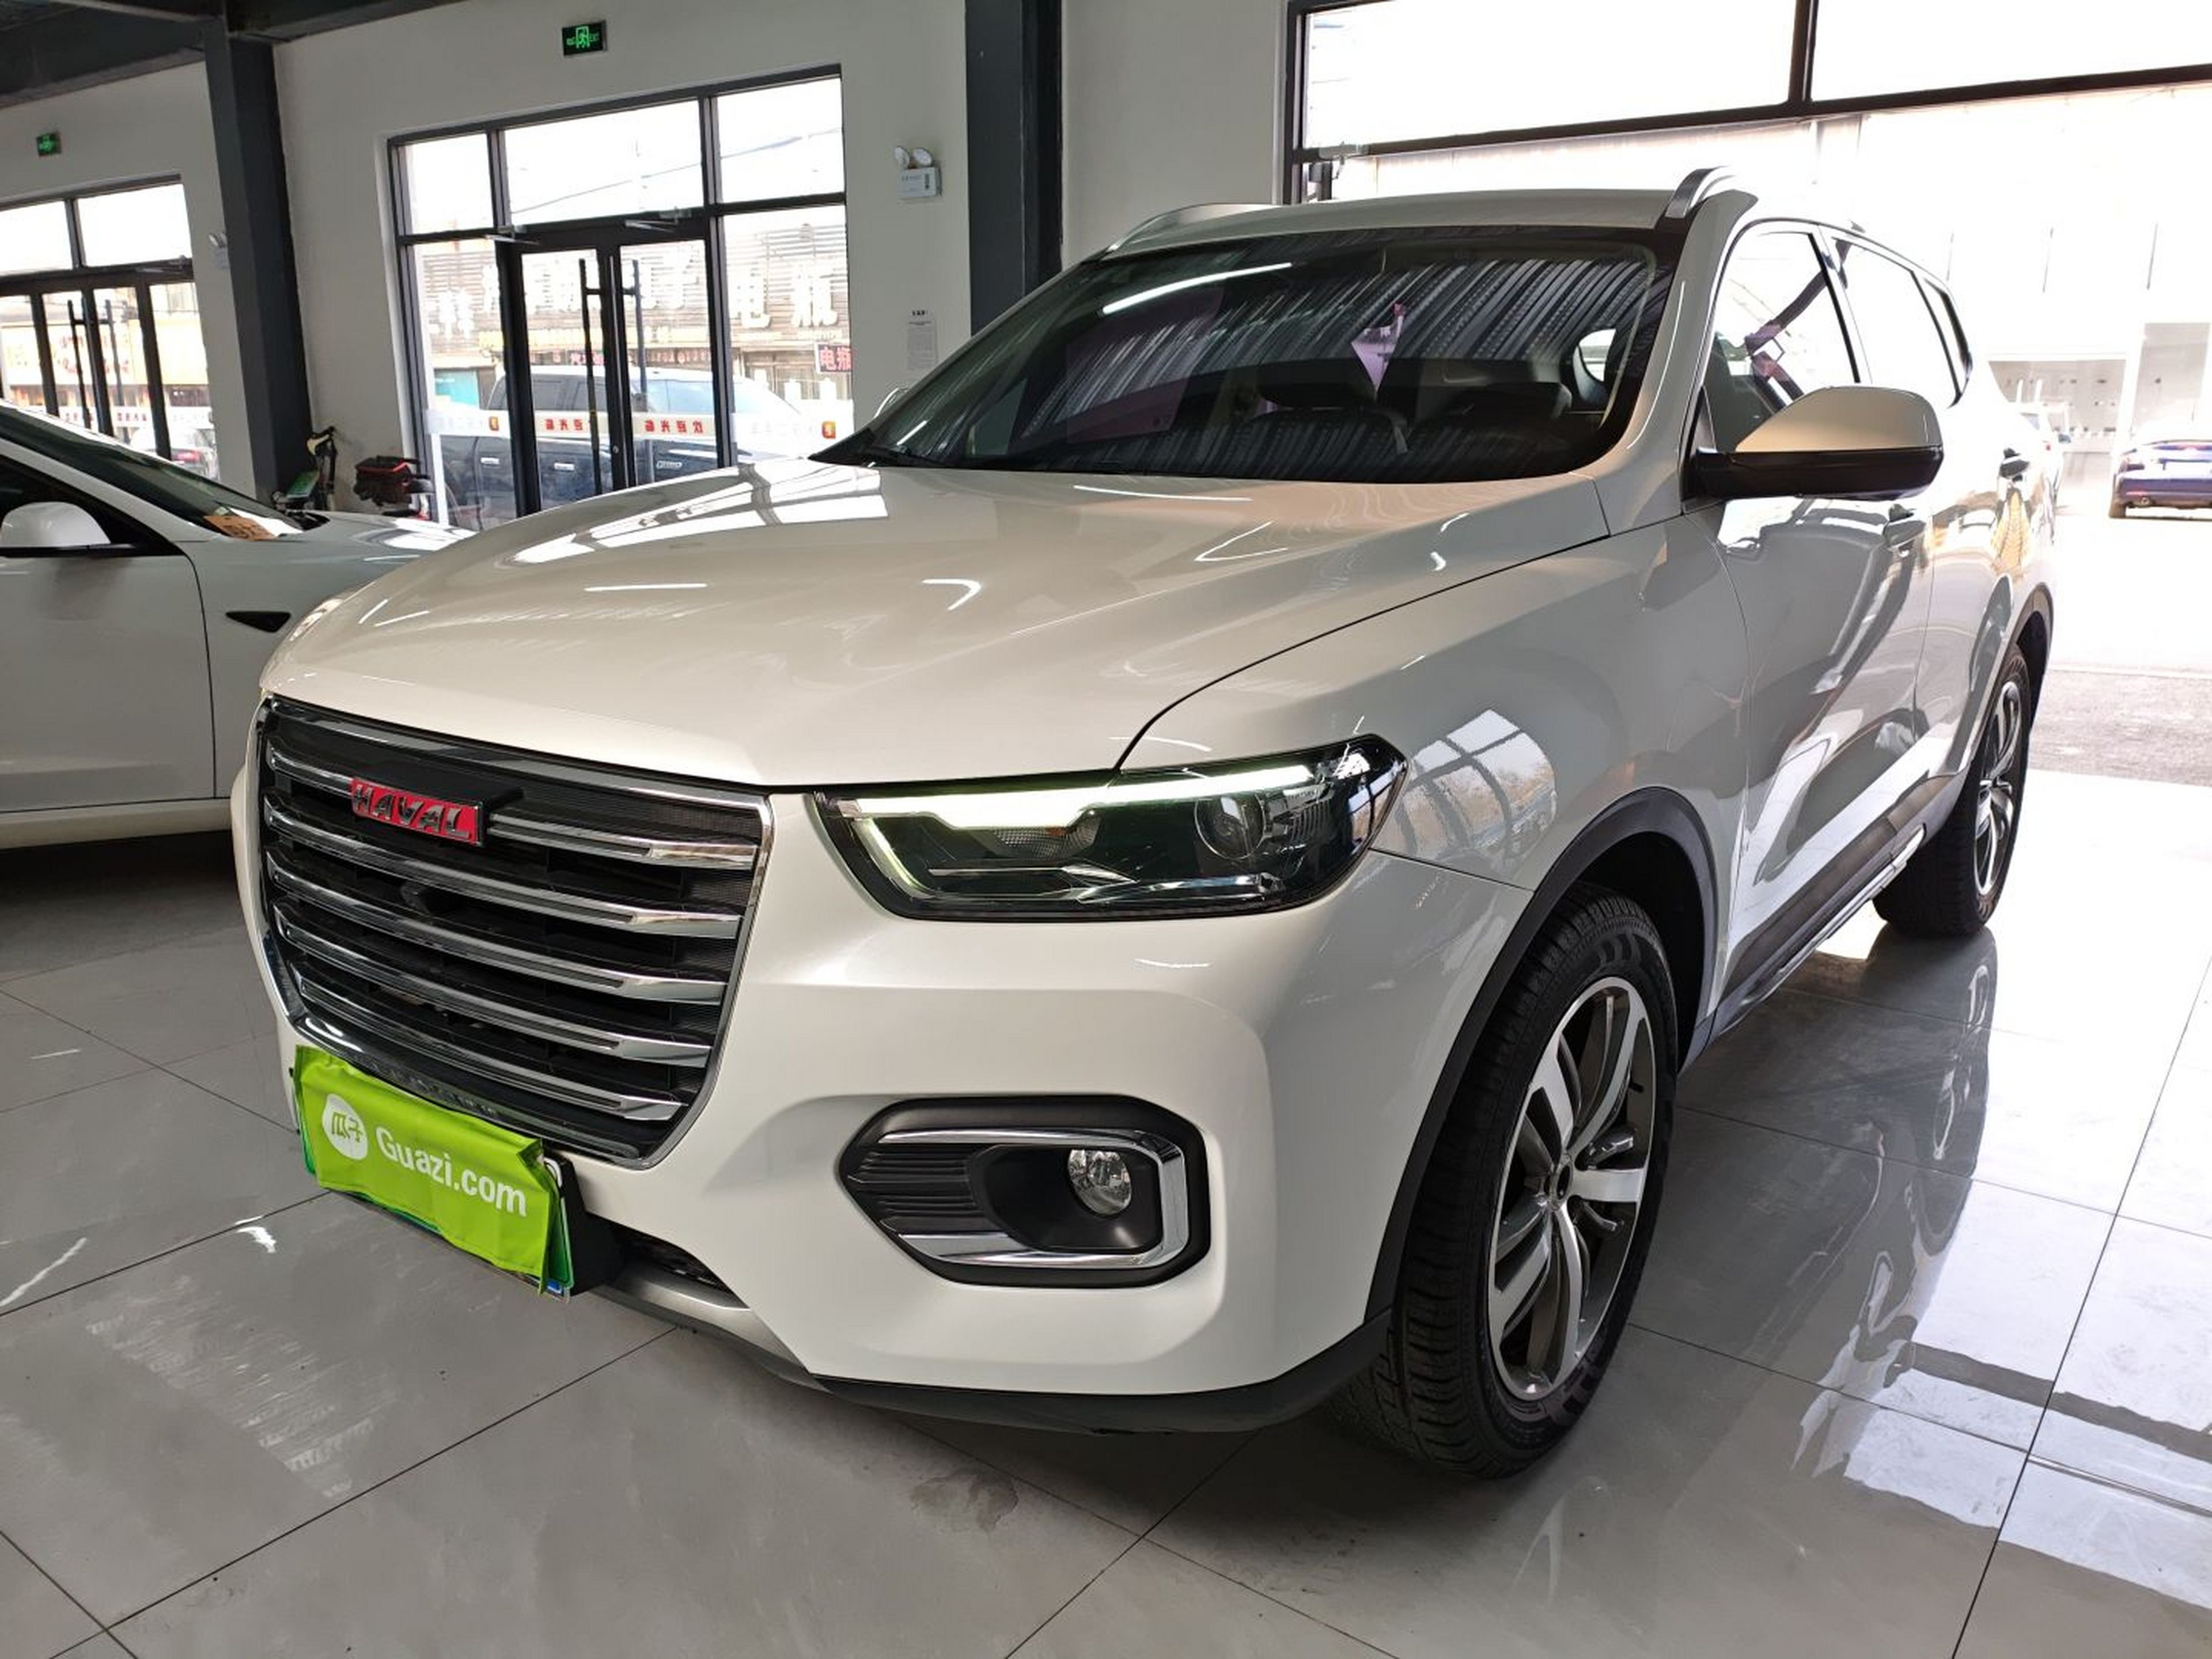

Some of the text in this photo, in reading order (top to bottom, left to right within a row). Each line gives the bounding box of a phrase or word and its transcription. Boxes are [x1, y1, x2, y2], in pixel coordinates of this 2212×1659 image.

[820, 346, 851, 370] 电瓶
[352, 784, 469, 838] HAVAL
[376, 1127, 527, 1218] Guazi.com
